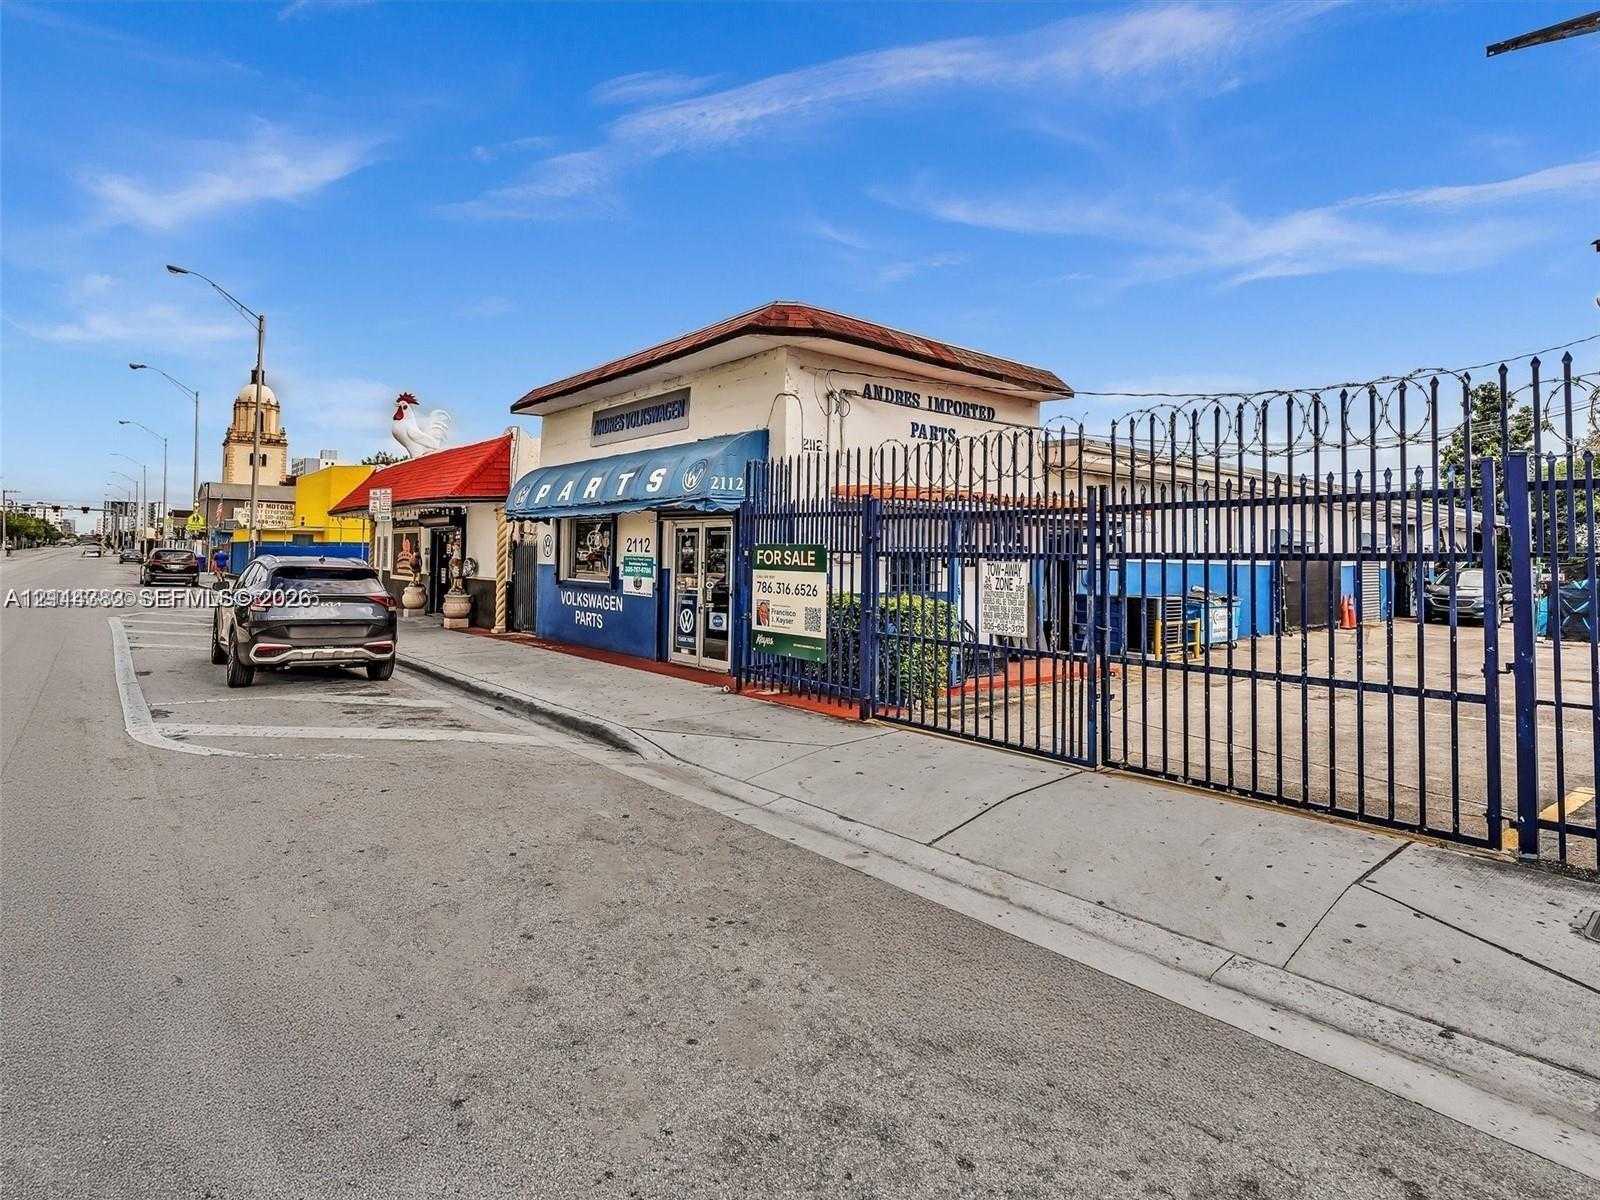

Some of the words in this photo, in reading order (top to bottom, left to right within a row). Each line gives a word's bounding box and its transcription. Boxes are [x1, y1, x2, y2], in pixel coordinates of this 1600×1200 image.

[862, 383, 921, 408] ANDRES
[927, 396, 996, 421] IMPORTED
[593, 413, 625, 436] ANDRES
[625, 399, 685, 430] VOLKSWAGEN
[910, 422, 956, 443] PARTS
[534, 468, 667, 504] PARTS
[710, 477, 744, 491] 2112
[626, 537, 650, 553] 2112
[757, 550, 781, 565] FOR
[783, 550, 816, 566] SALE
[986, 563, 1022, 577] TOW-AWAY
[757, 581, 818, 597] 786.316.6526
[995, 577, 1014, 591] ZONE
[561, 590, 623, 612] VOLKSWAGEN
[575, 610, 603, 628] PARTS
